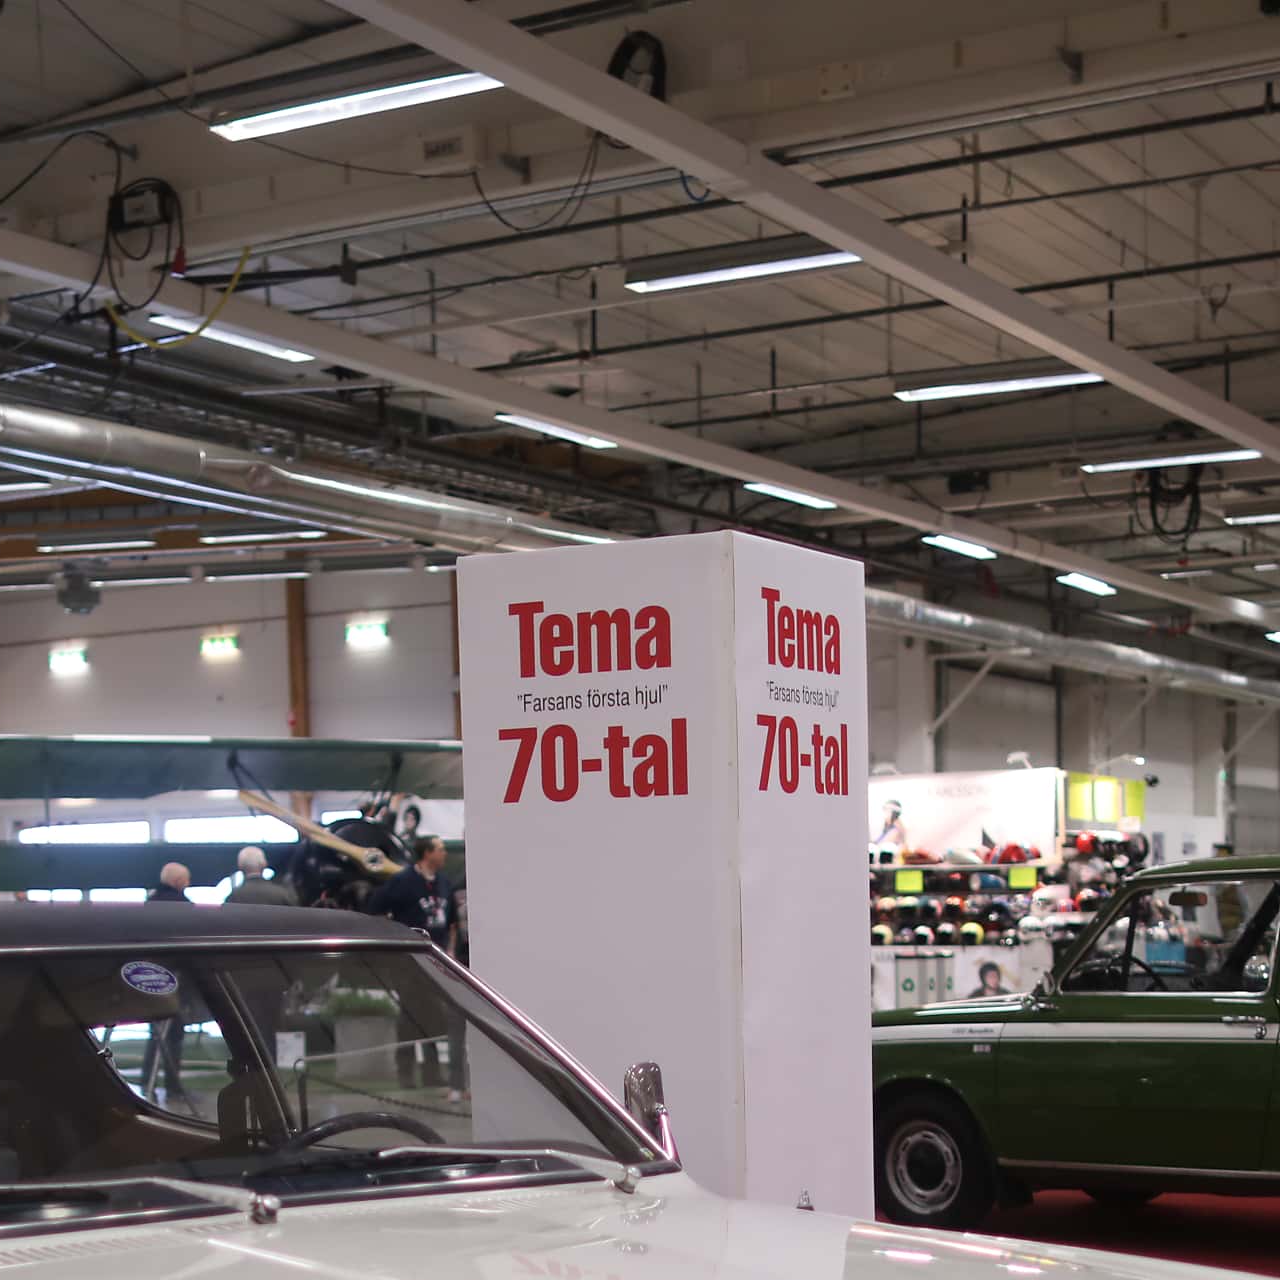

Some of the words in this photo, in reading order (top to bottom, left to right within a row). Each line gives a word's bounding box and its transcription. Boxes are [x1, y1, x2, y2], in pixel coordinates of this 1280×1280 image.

[508, 600, 671, 678] Tema
[761, 587, 841, 675] Tema
[517, 693, 583, 713] "Farsans
[587, 689, 630, 708] första
[634, 684, 668, 710] hjul"
[802, 684, 824, 706] första
[498, 718, 689, 804] 70-tal
[756, 714, 849, 797] 70-tal
